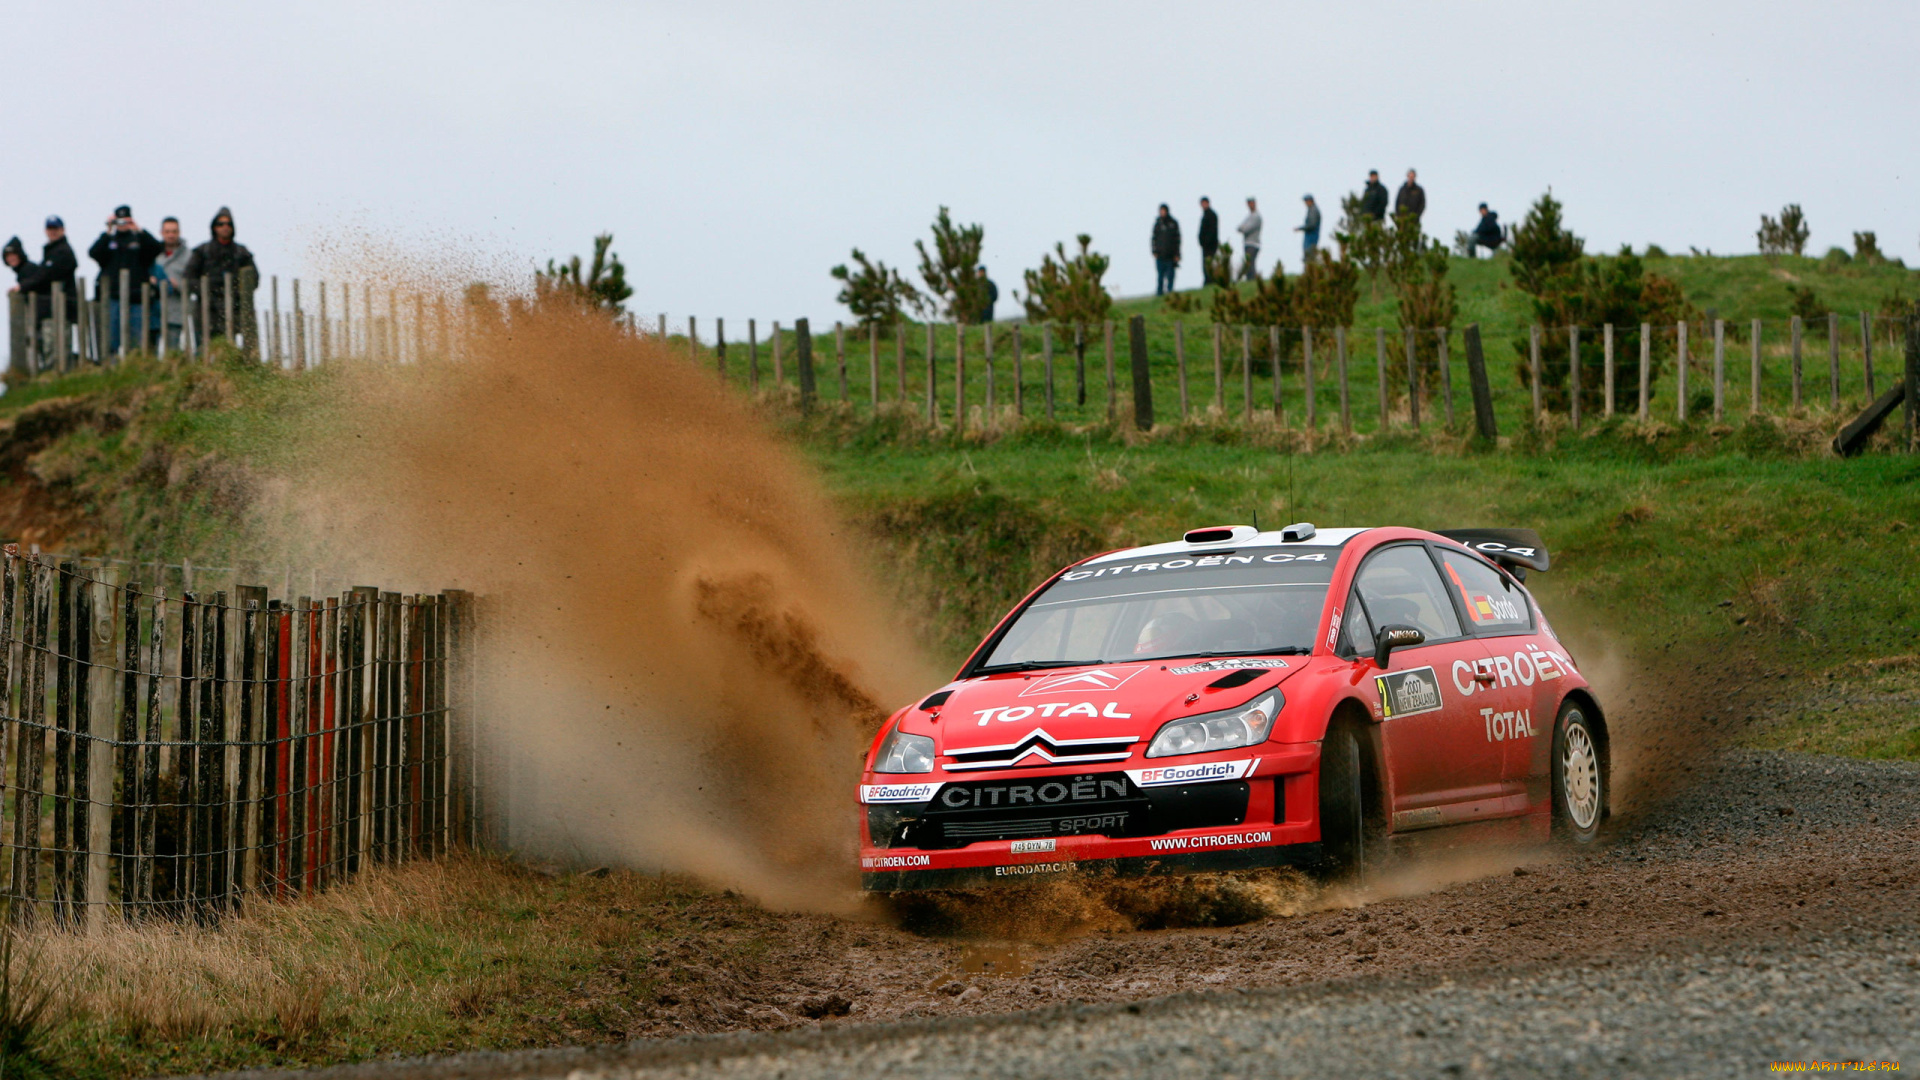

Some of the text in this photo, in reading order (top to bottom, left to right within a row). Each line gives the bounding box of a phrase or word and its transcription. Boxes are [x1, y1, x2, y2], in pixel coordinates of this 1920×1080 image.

[1476, 542, 1535, 557] C4
[1061, 553, 1328, 581] CITROËN C4
[1487, 594, 1519, 619] Sordo
[1388, 630, 1420, 640] NIKKO
[1452, 643, 1578, 697] CITROËN
[1405, 679, 1421, 695] 2007
[1411, 692, 1436, 708] ZEALAND
[973, 702, 1132, 727] TOTAL
[1480, 707, 1539, 743] TOTAL
[1141, 763, 1235, 782] BFGoodrich
[868, 785, 931, 798] BFGoodrich
[941, 775, 1128, 808] CITROËN
[1058, 815, 1127, 832] SPORT
[1150, 832, 1272, 851] WWW.CITROEN.COM
[995, 862, 1077, 876] EURODATACAR
